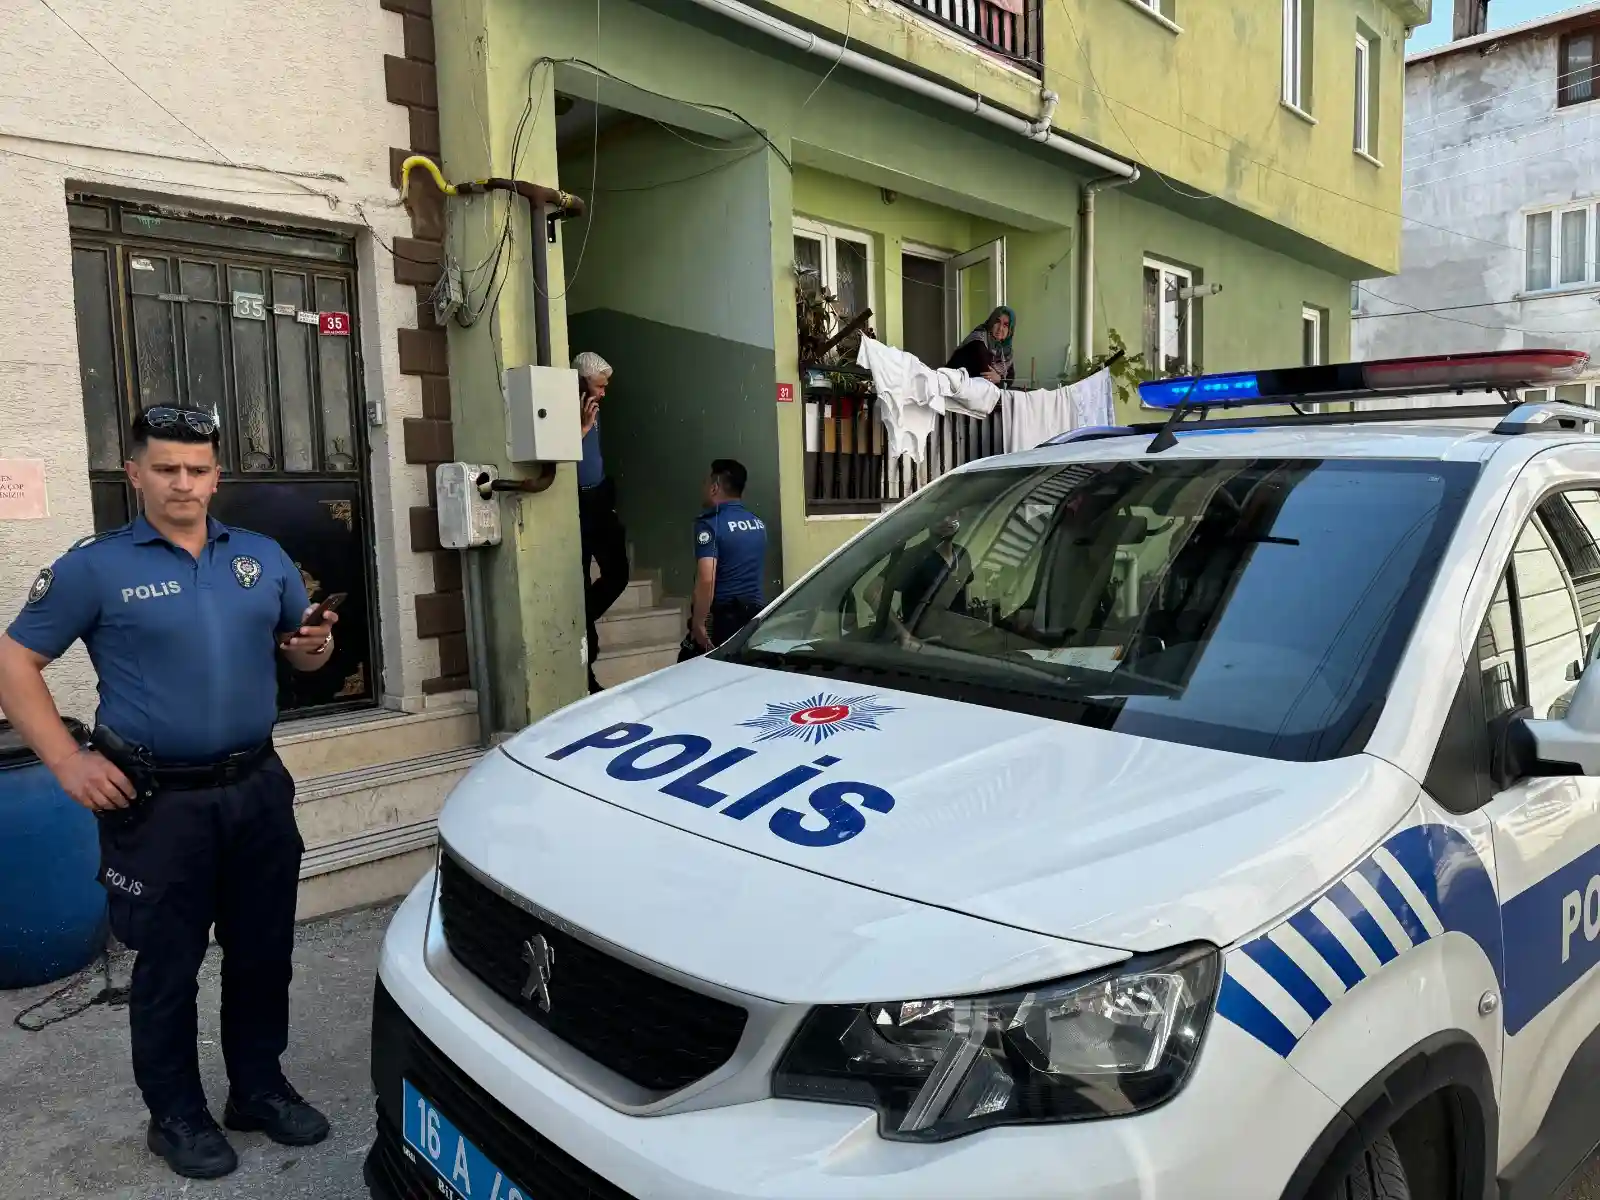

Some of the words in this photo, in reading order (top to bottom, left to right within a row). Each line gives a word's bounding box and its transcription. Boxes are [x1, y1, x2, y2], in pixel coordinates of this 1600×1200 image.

[239, 299, 264, 318] 35
[327, 317, 342, 330] 35
[1562, 874, 1600, 964] PO
[418, 1098, 441, 1160] 16
[453, 1135, 471, 1196] A
